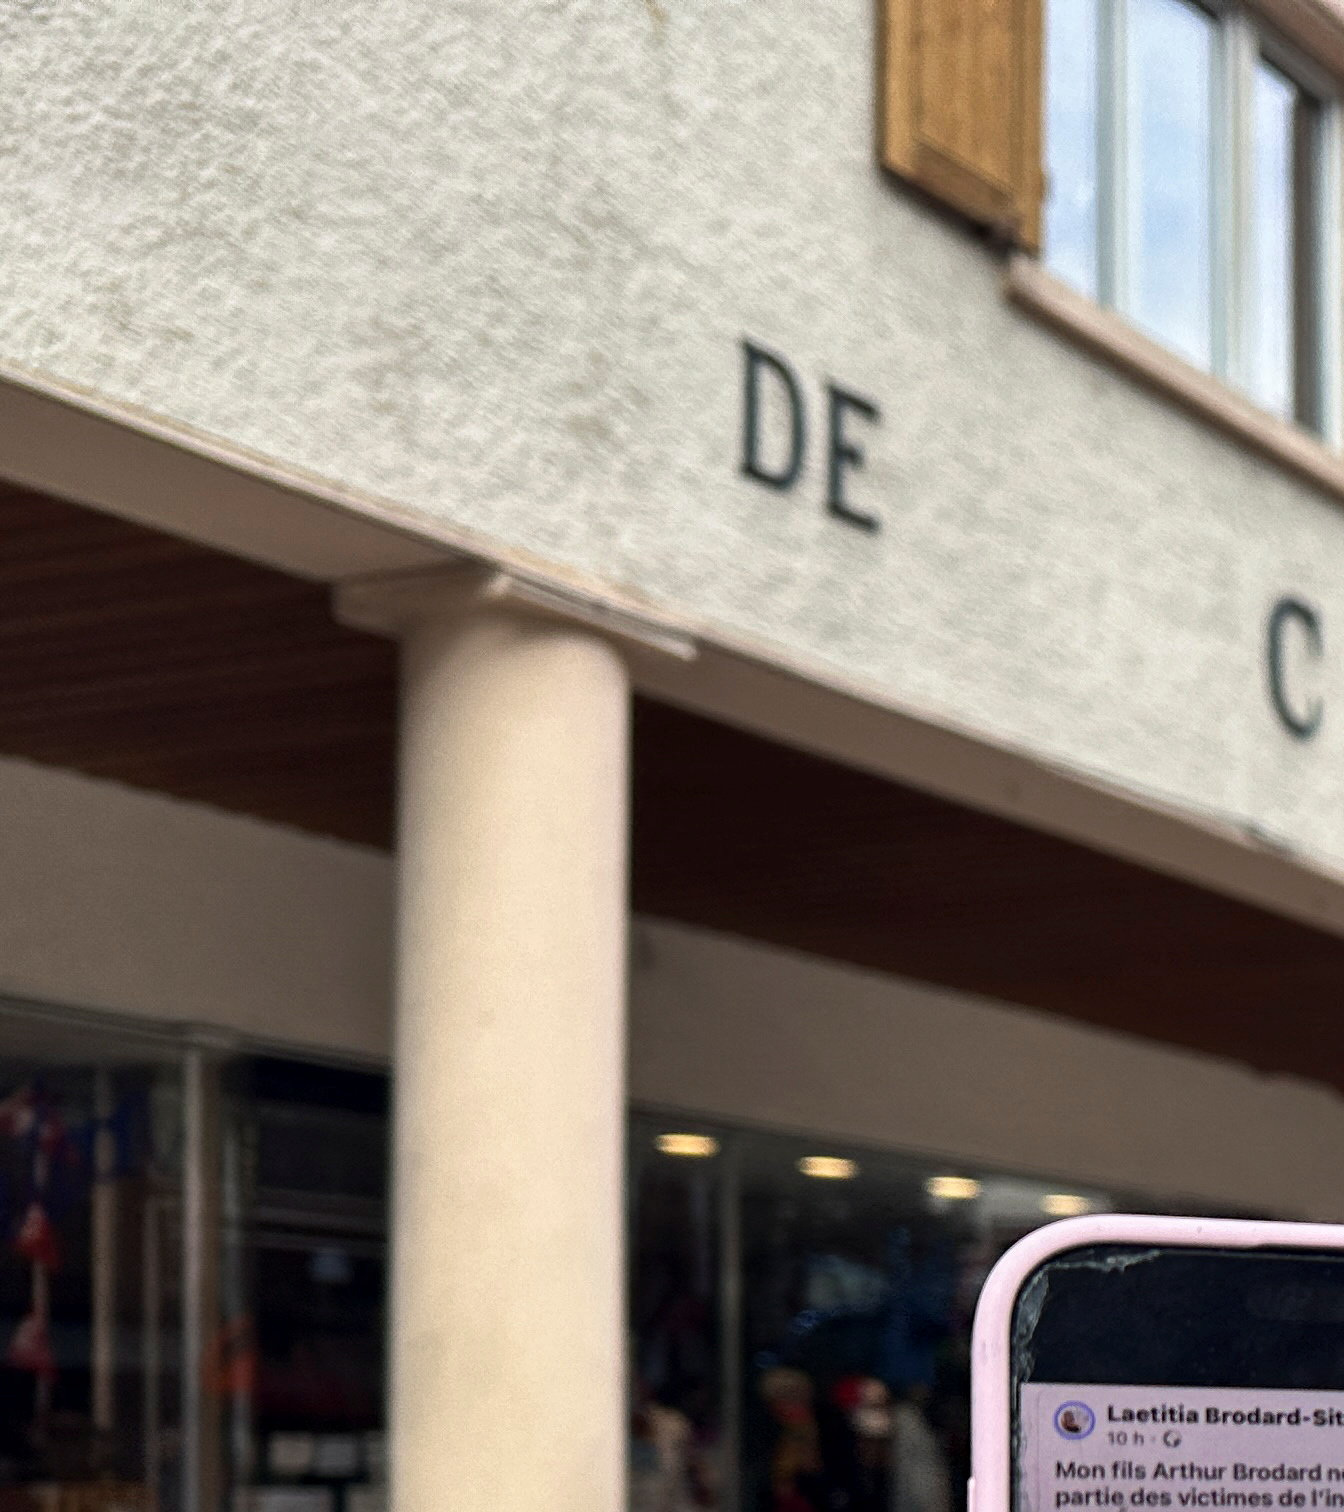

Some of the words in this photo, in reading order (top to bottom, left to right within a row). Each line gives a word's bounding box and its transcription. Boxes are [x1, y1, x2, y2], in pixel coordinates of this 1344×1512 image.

[739, 338, 882, 533] DE
[1107, 1404, 1200, 1424] Laetitia
[1107, 1431, 1128, 1446] 10
[1133, 1430, 1145, 1446] h
[1055, 1461, 1106, 1480] Mon
[1112, 1460, 1147, 1480] fils
[1153, 1461, 1227, 1481] Arthur
[1232, 1462, 1322, 1482] Brodard
[1055, 1487, 1125, 1508] partie
[1130, 1487, 1172, 1506] des
[1178, 1487, 1273, 1507] victimes
[1278, 1489, 1306, 1507] de
